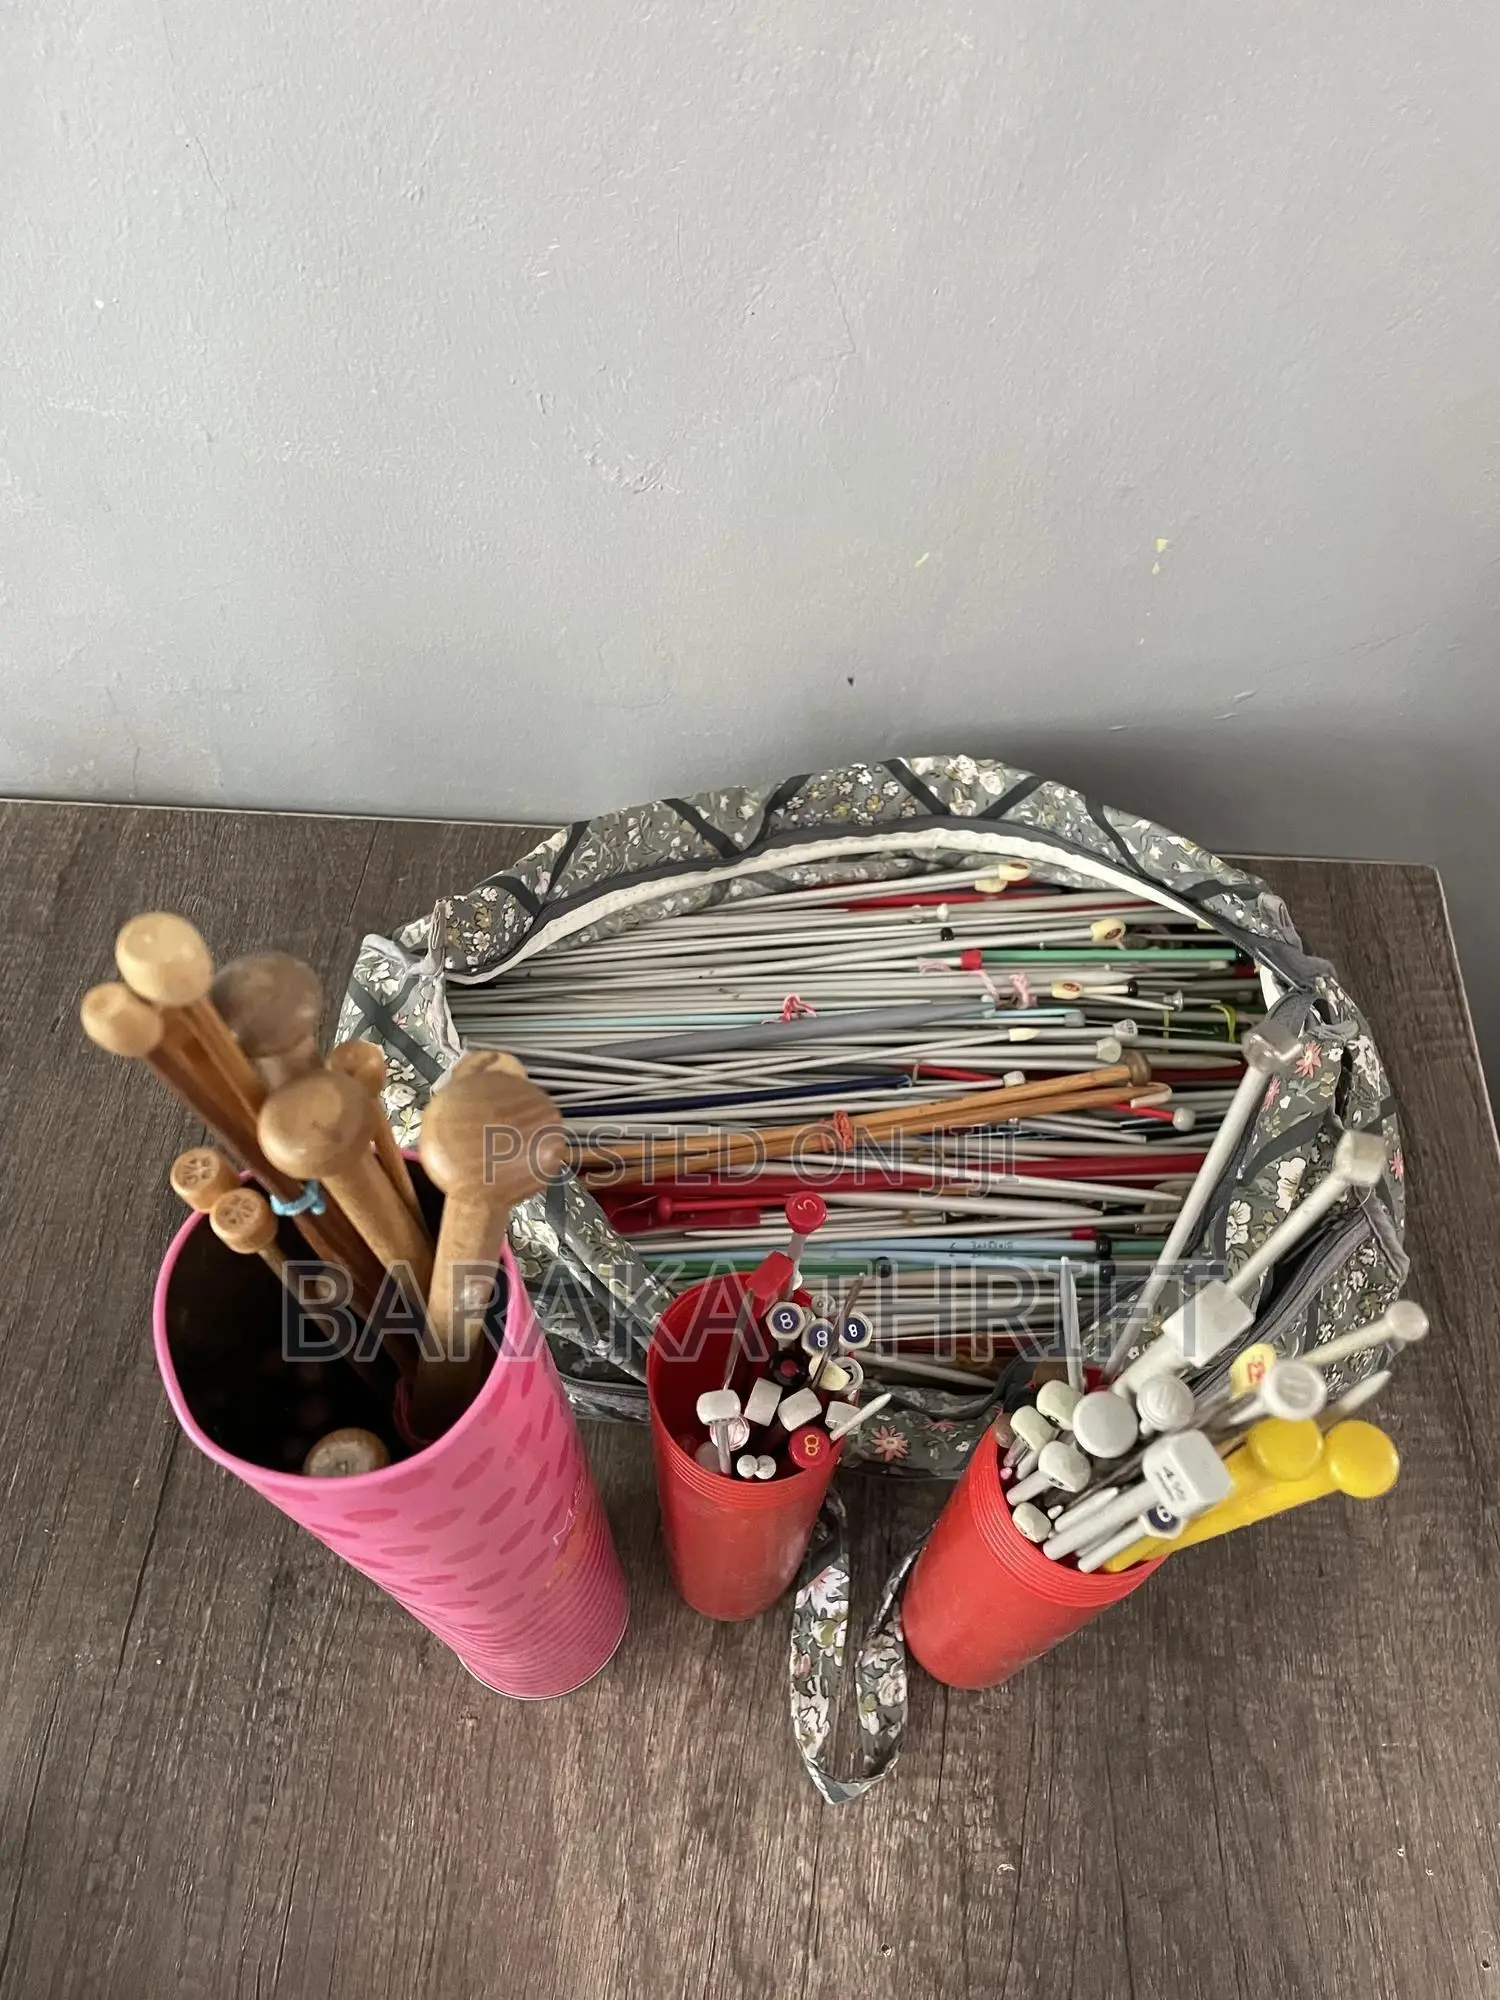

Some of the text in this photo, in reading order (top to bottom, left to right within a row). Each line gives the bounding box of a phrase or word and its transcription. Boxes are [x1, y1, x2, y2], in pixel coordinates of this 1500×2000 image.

[779, 1312, 794, 1330] 8
[816, 1330, 828, 1348] 8
[848, 1324, 858, 1338] 8
[803, 1434, 820, 1457] 8
